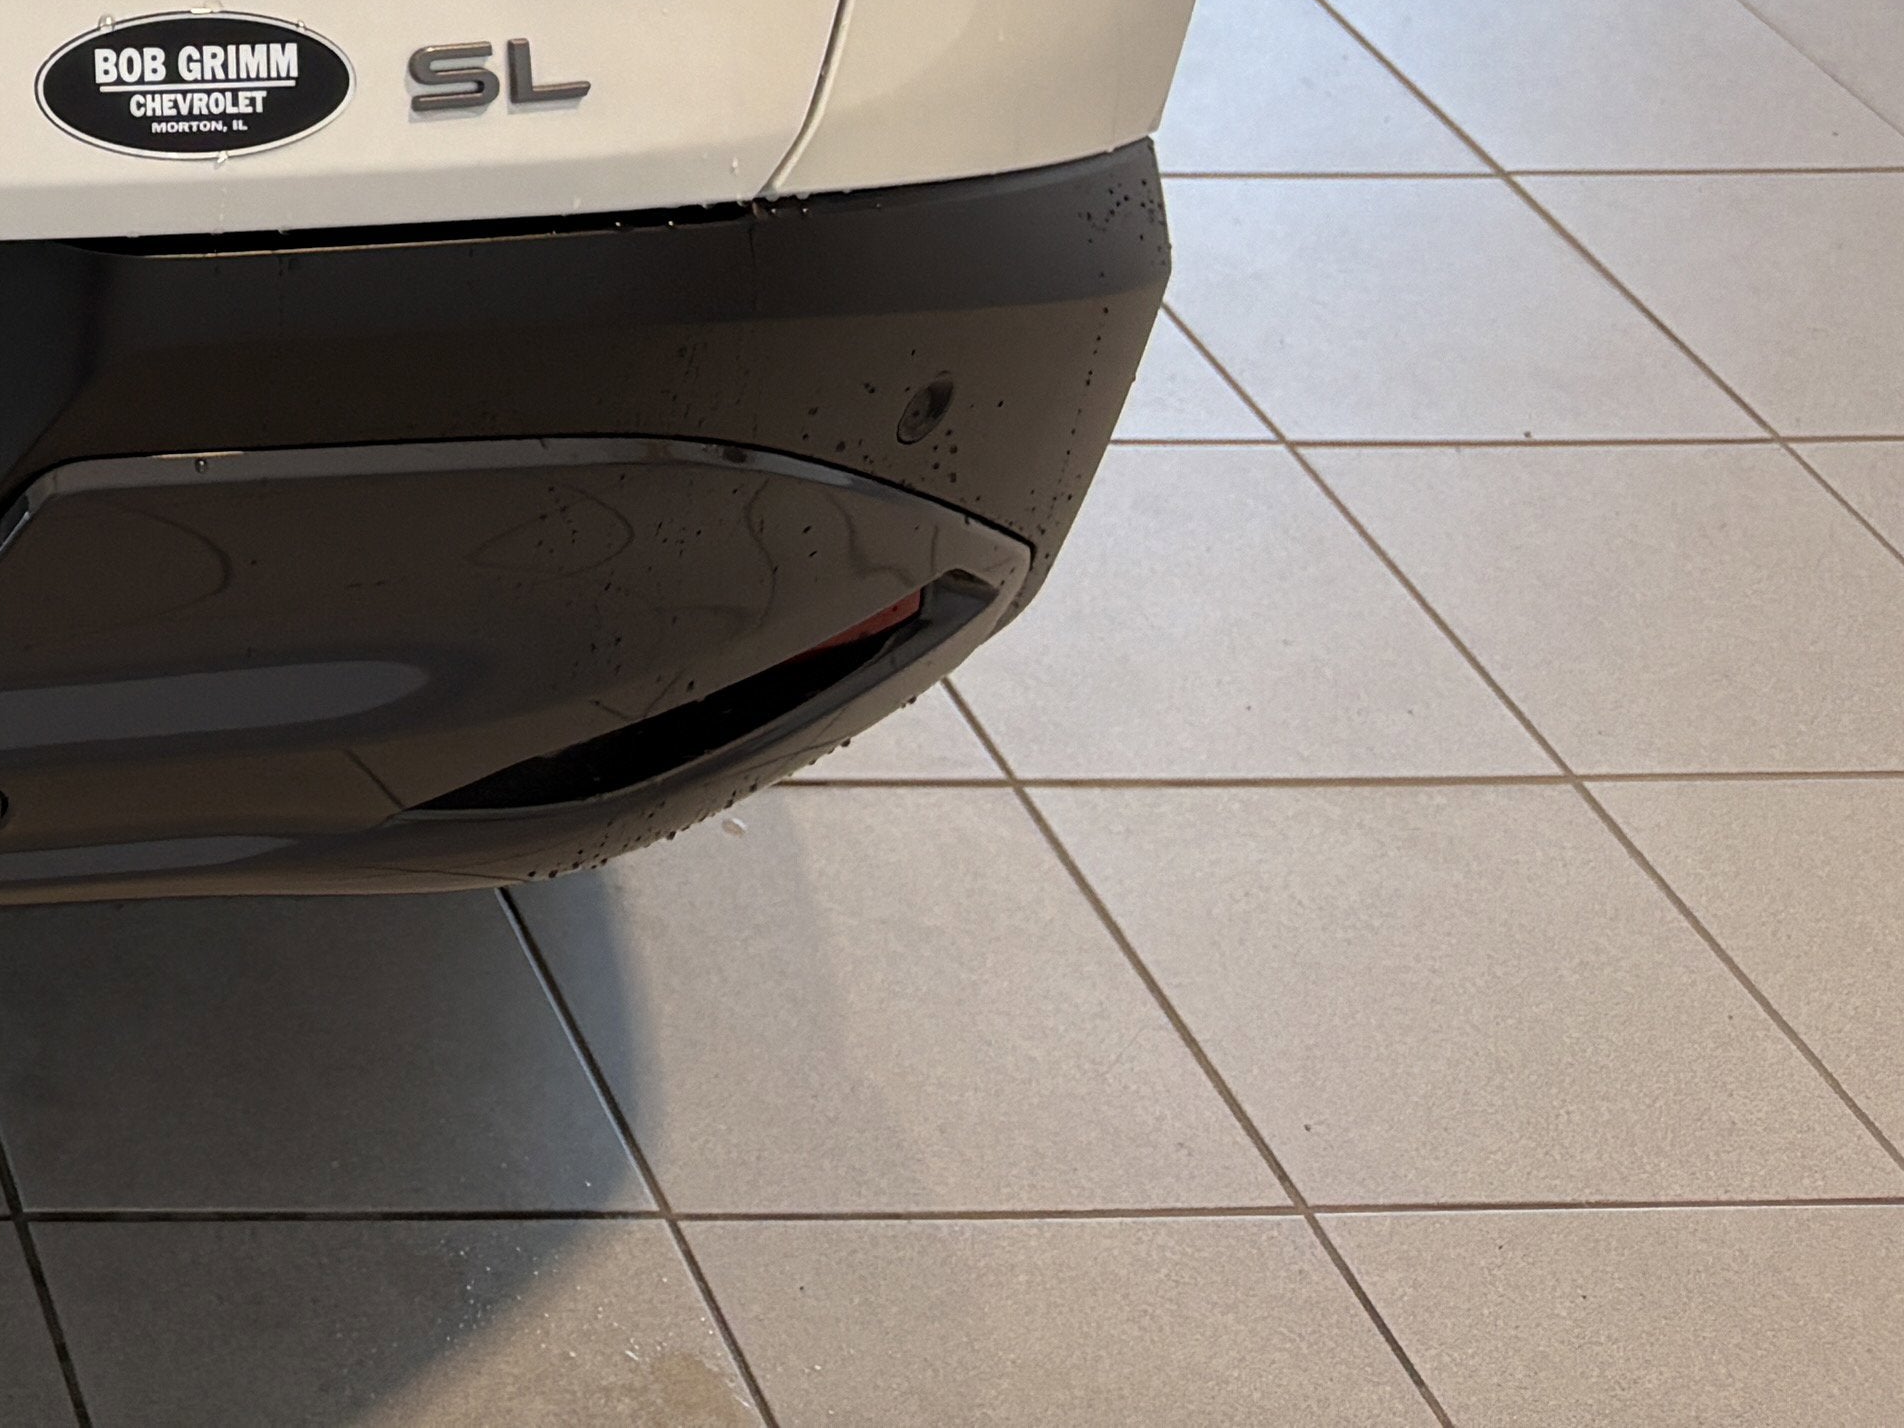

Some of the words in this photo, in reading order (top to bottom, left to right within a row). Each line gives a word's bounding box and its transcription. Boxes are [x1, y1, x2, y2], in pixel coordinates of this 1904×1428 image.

[94, 47, 167, 84] BOB
[177, 43, 299, 81] GRIMM
[410, 38, 592, 111] SL
[129, 90, 268, 118] CHEVROLET
[151, 120, 228, 134] MORTON,
[232, 119, 248, 132] IL
